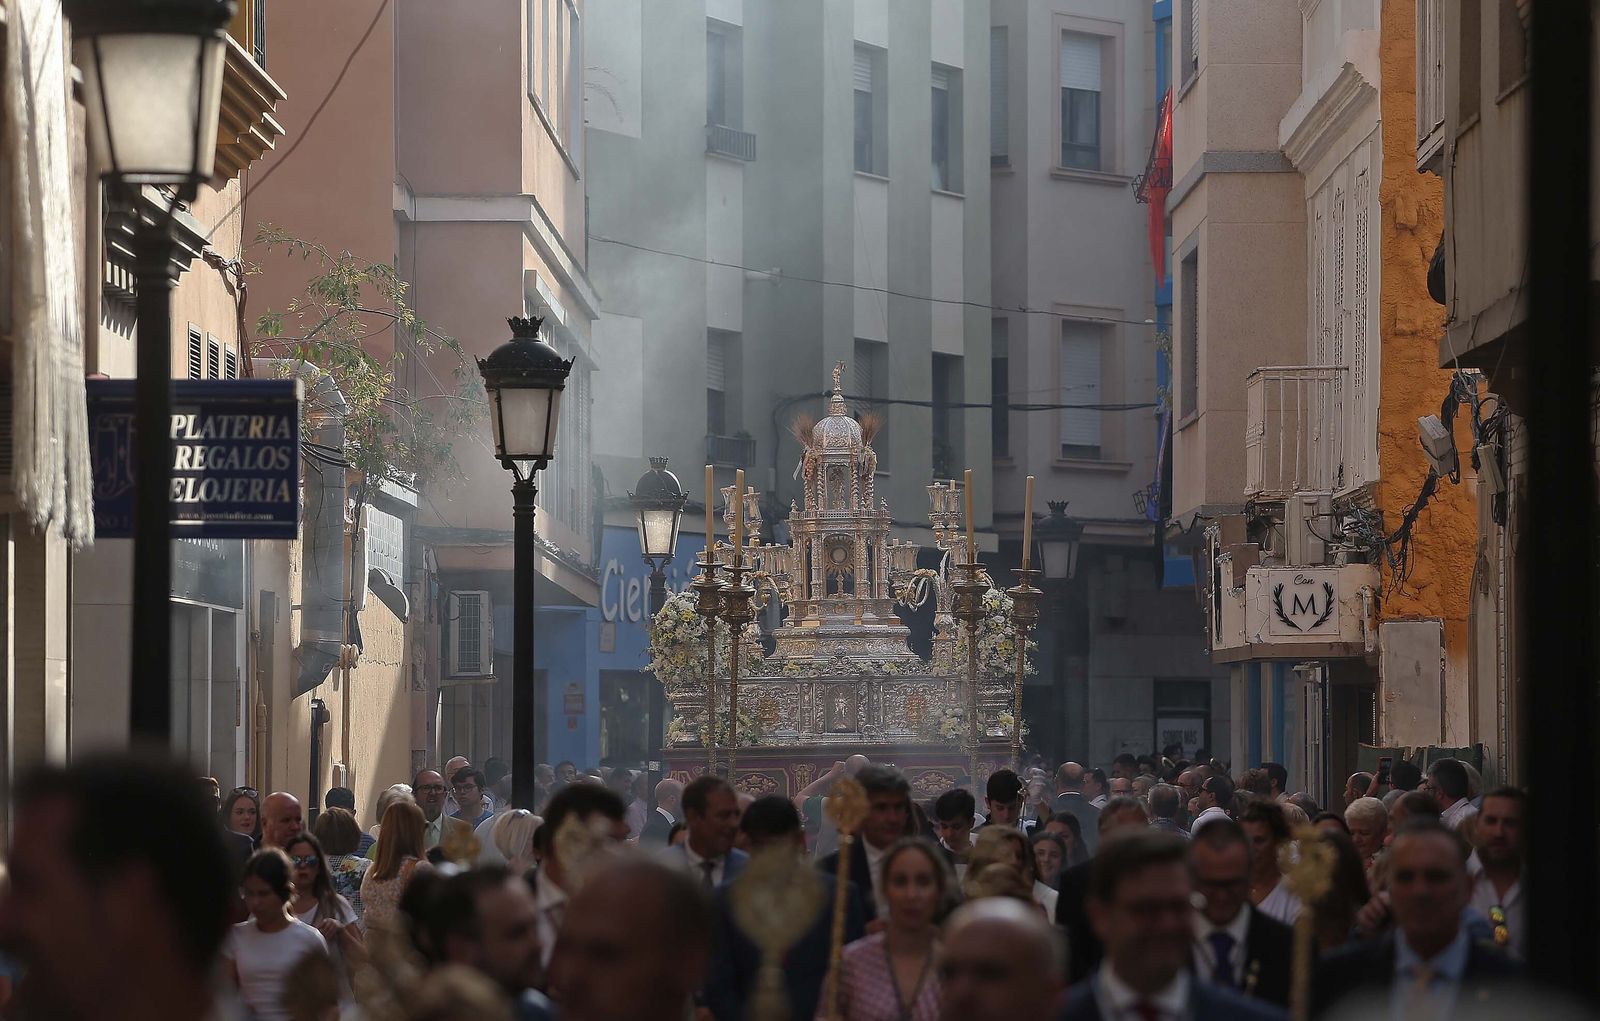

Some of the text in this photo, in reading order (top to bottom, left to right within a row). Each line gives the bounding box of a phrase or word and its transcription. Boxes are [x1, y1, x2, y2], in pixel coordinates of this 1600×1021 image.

[169, 413, 291, 440] PLATERIA
[173, 444, 291, 471] REGALOS
[168, 476, 291, 503] ELOJERIA
[1290, 593, 1319, 616] M
